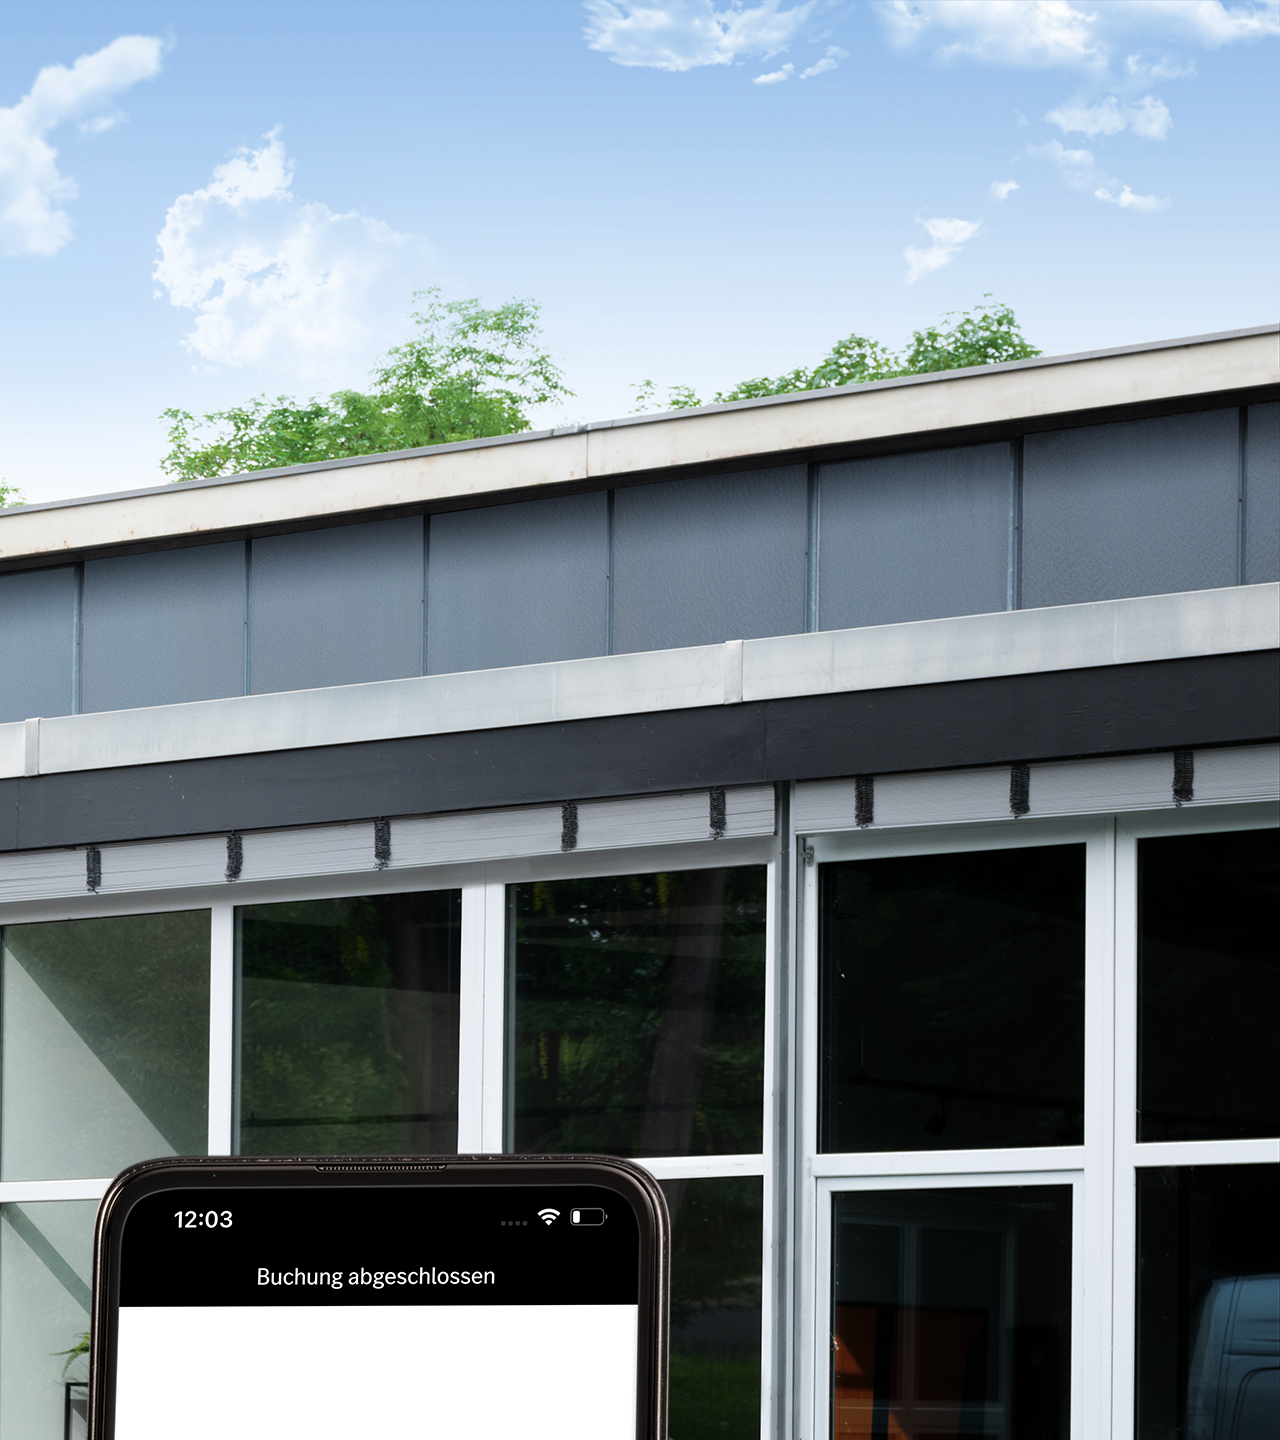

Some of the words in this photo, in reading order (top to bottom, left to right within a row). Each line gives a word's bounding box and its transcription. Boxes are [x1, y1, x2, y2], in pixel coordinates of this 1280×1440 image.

[173, 1210, 233, 1229] 12:03
[257, 1267, 343, 1290] Buchung
[348, 1267, 496, 1290] abgeschlossen
